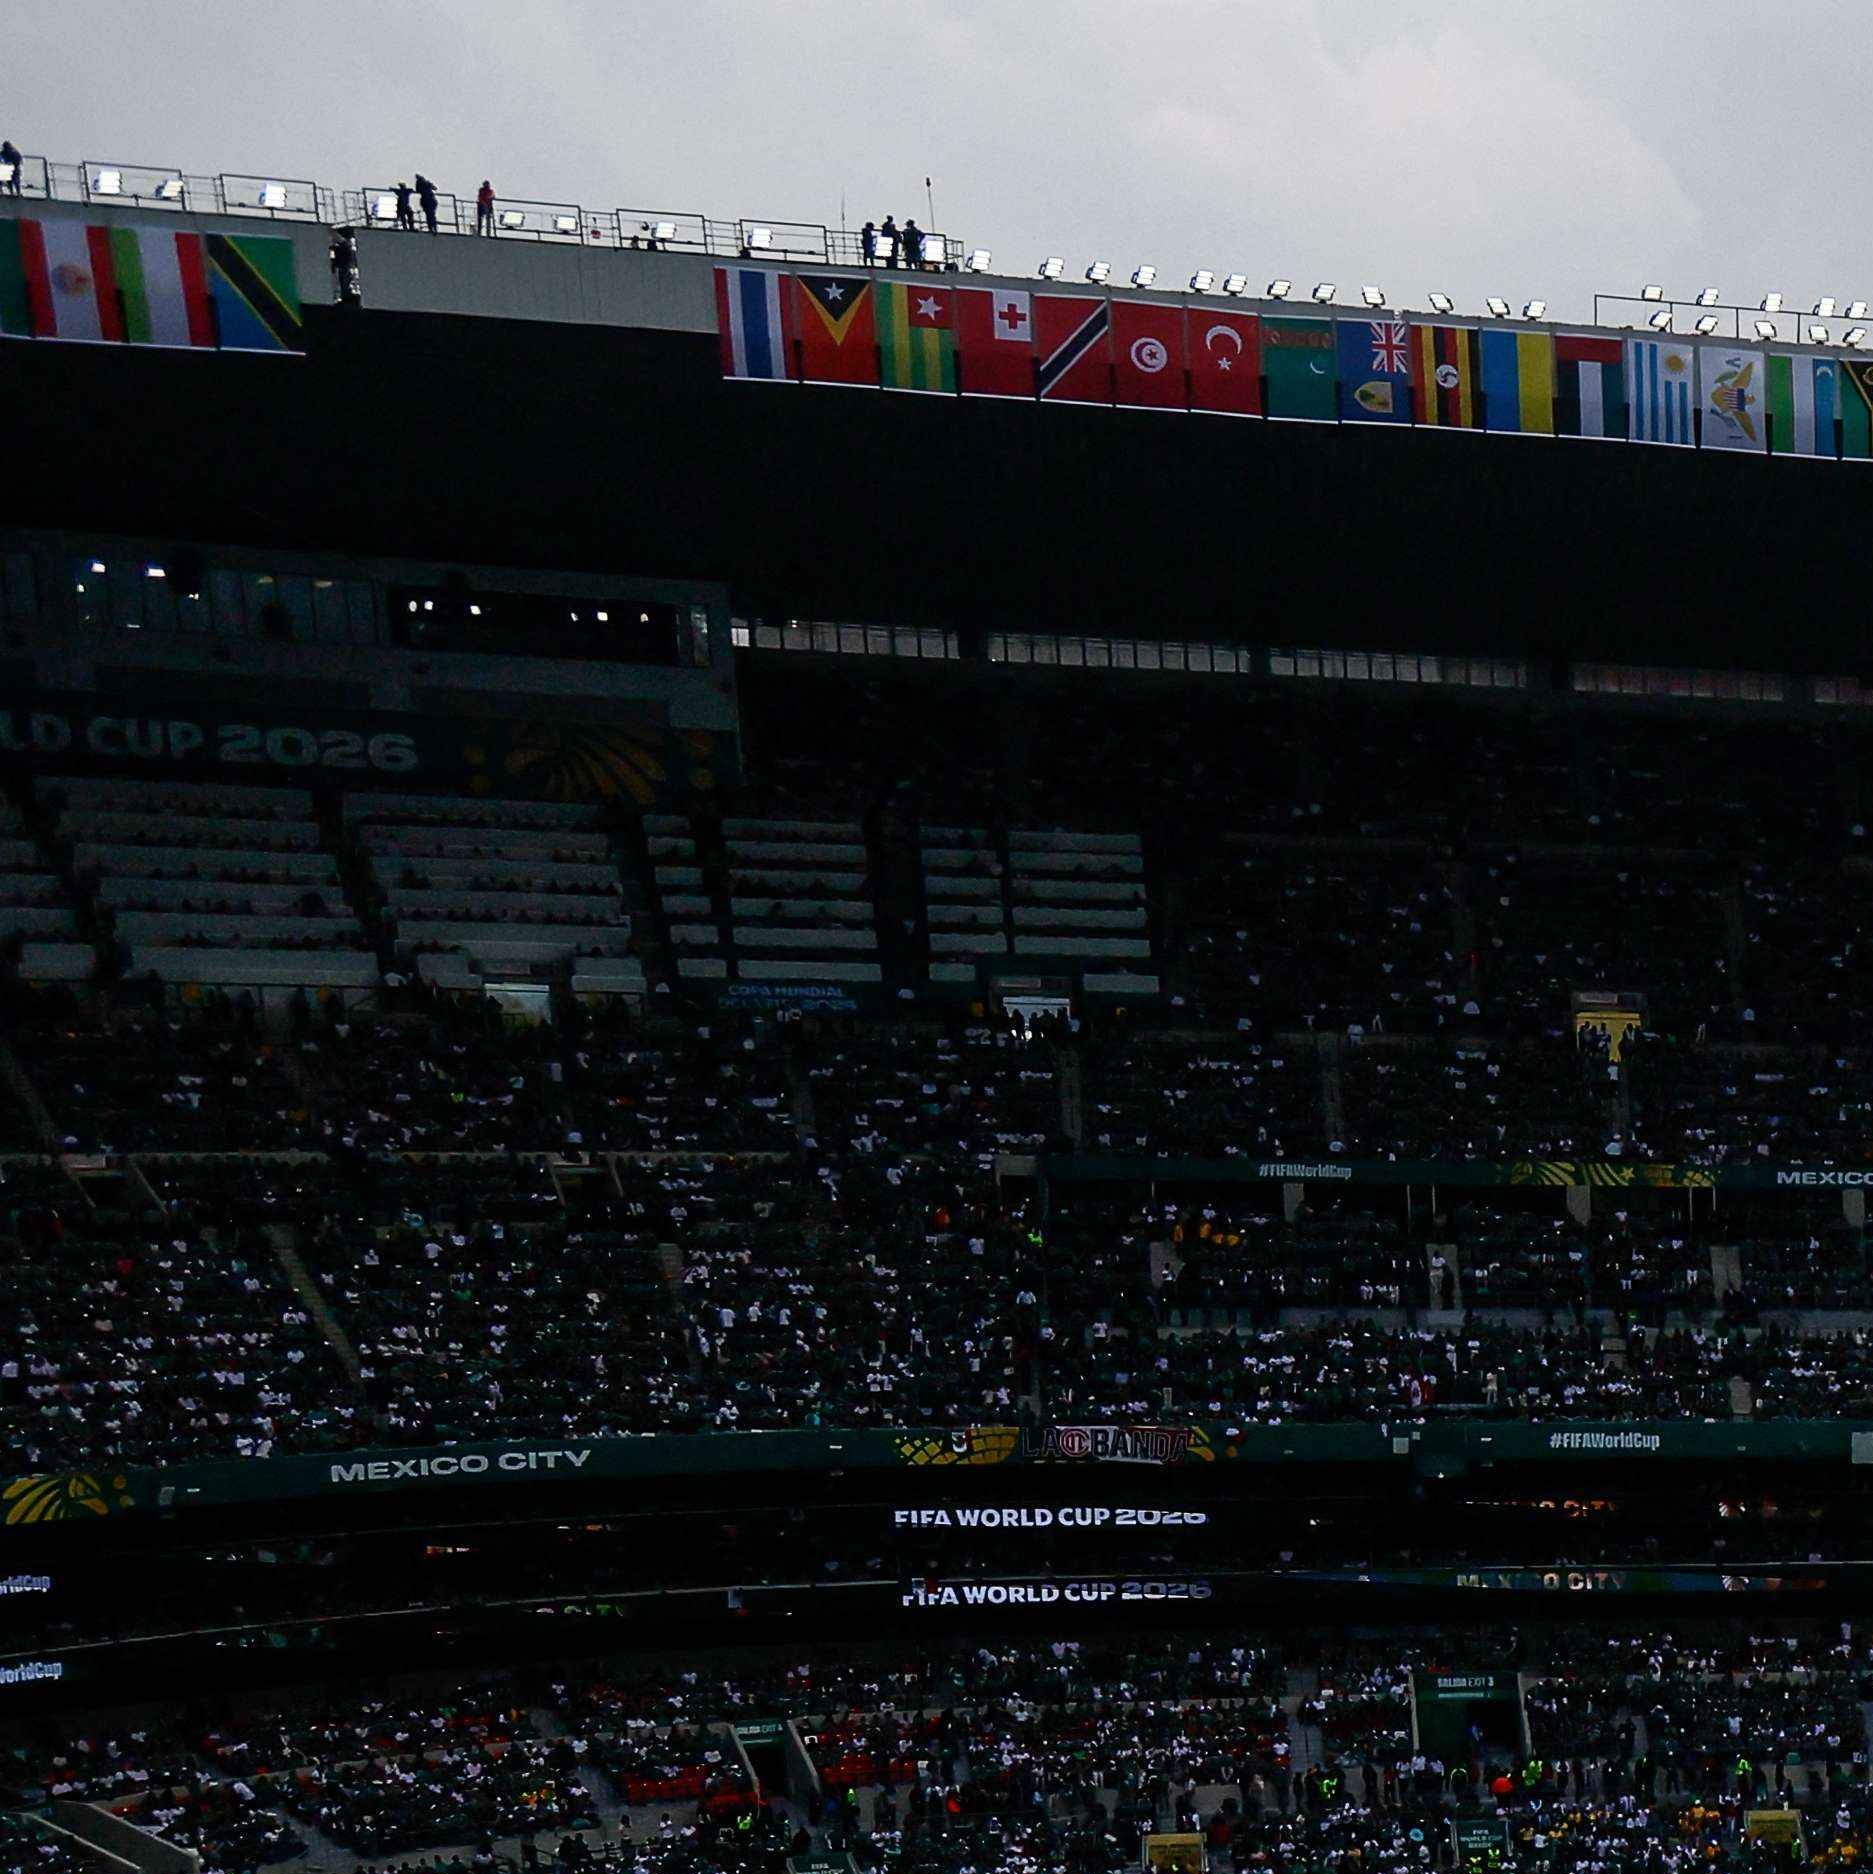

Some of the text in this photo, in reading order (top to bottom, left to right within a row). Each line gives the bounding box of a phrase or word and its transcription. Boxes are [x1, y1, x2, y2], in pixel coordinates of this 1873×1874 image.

[86, 716, 204, 760] CUP
[216, 721, 420, 776] 2026
[1549, 1432, 1661, 1451] #FIFAWorldCup
[331, 1449, 592, 1483] MEXICO CITY
[894, 1508, 1207, 1528] FIFA WORLD CUP 2026
[963, 1586, 1060, 1605] WORLD
[1064, 1584, 1116, 1602] CUP
[1121, 1582, 1213, 1600] 2026
